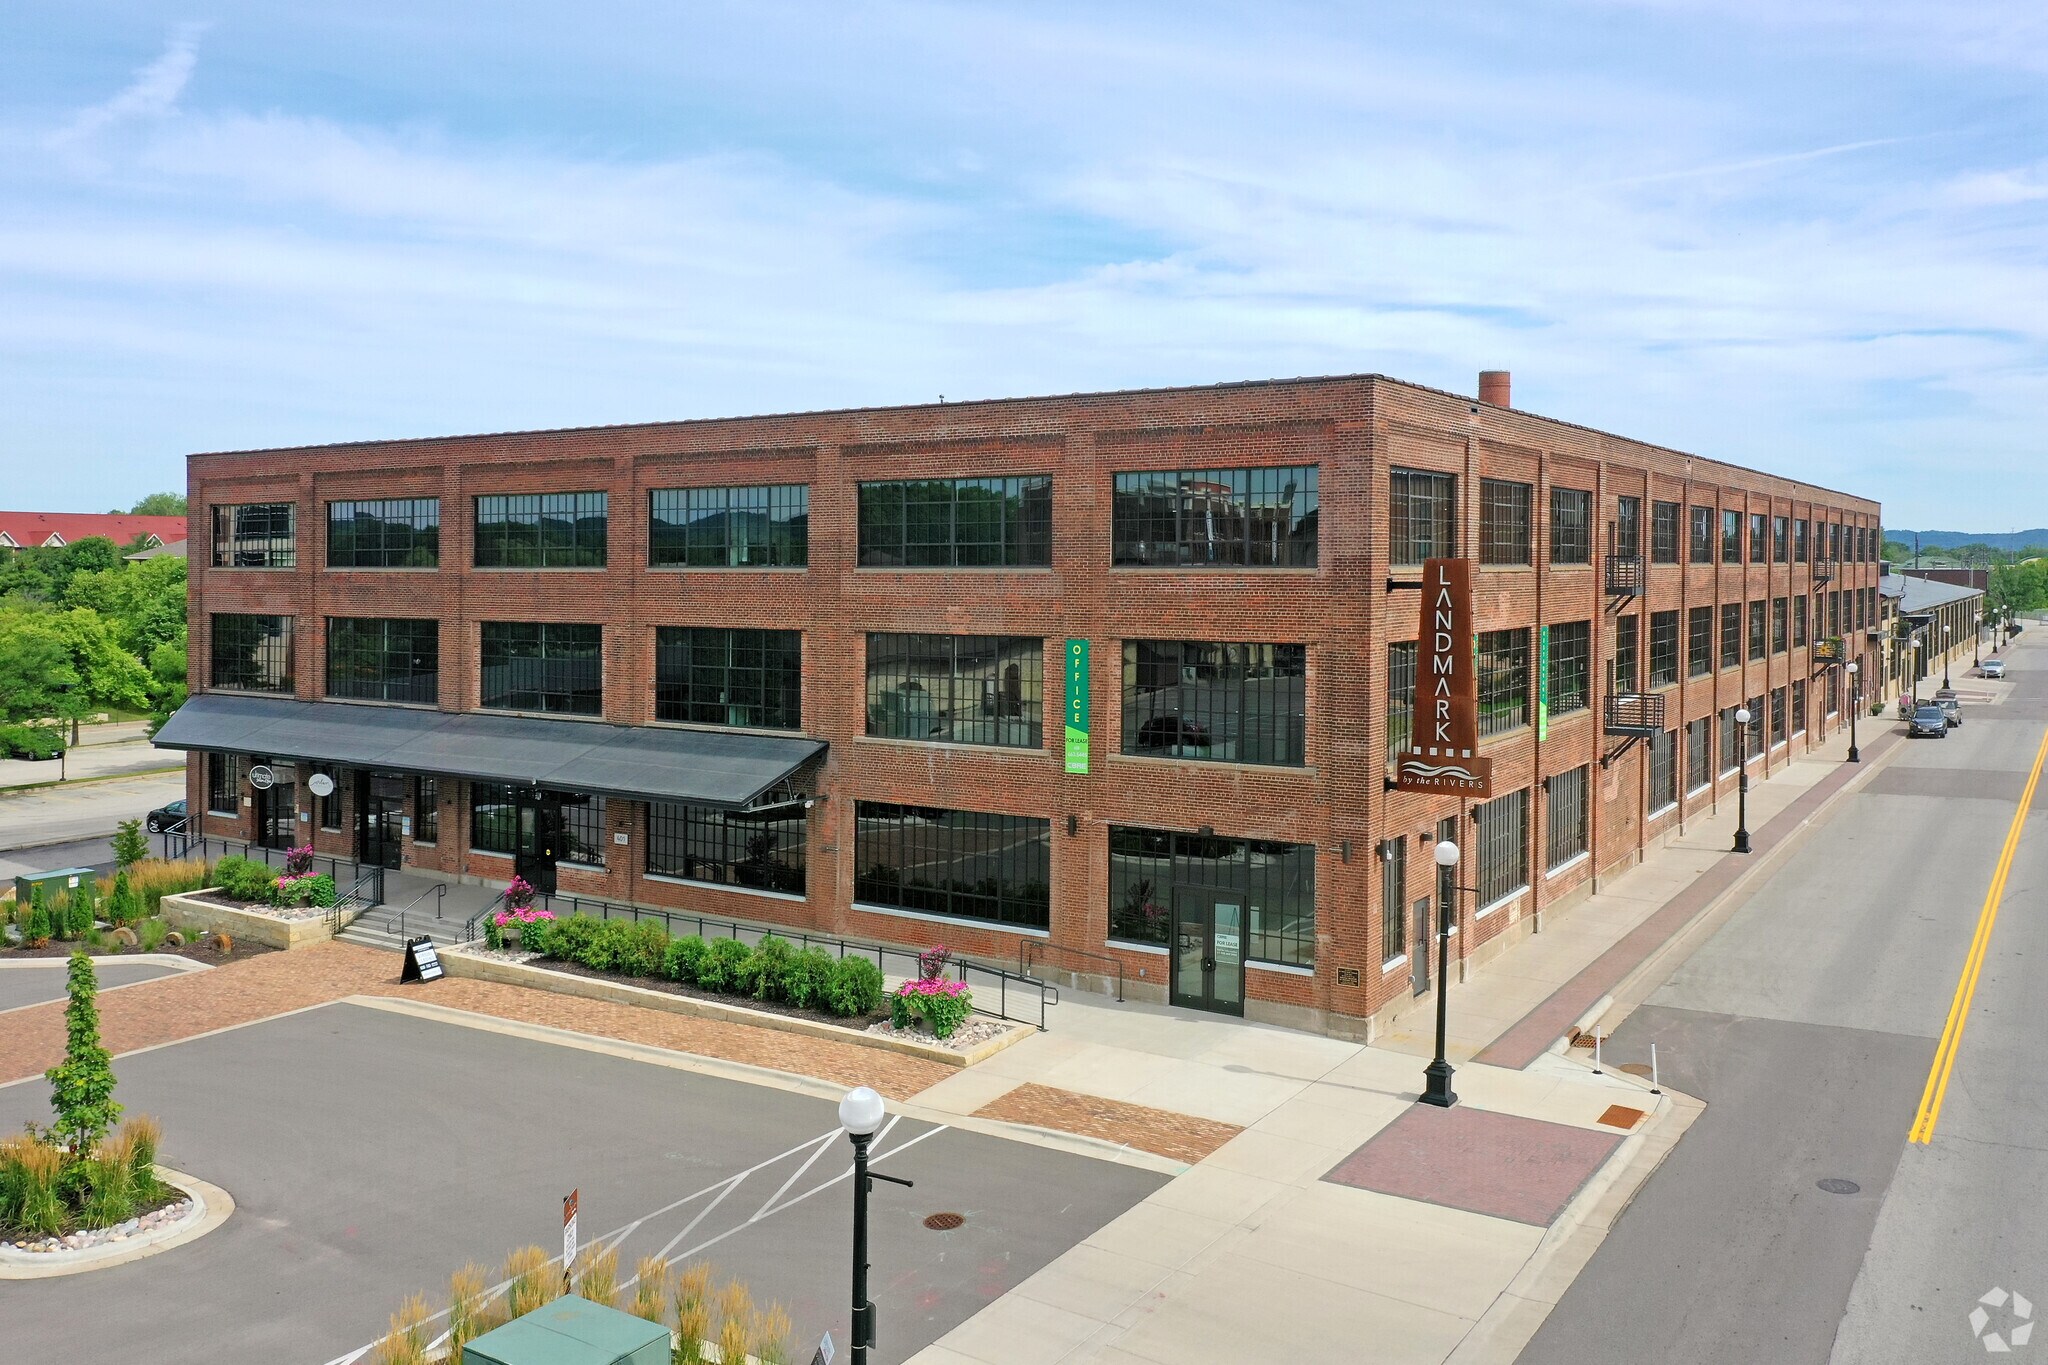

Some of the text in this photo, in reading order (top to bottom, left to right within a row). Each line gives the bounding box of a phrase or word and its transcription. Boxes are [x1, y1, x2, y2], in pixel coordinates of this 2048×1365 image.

[1072, 645, 1081, 723] OFFICE
[1433, 565, 1453, 742] LANDMARK
[1402, 775, 1484, 789] by the RIVERS
